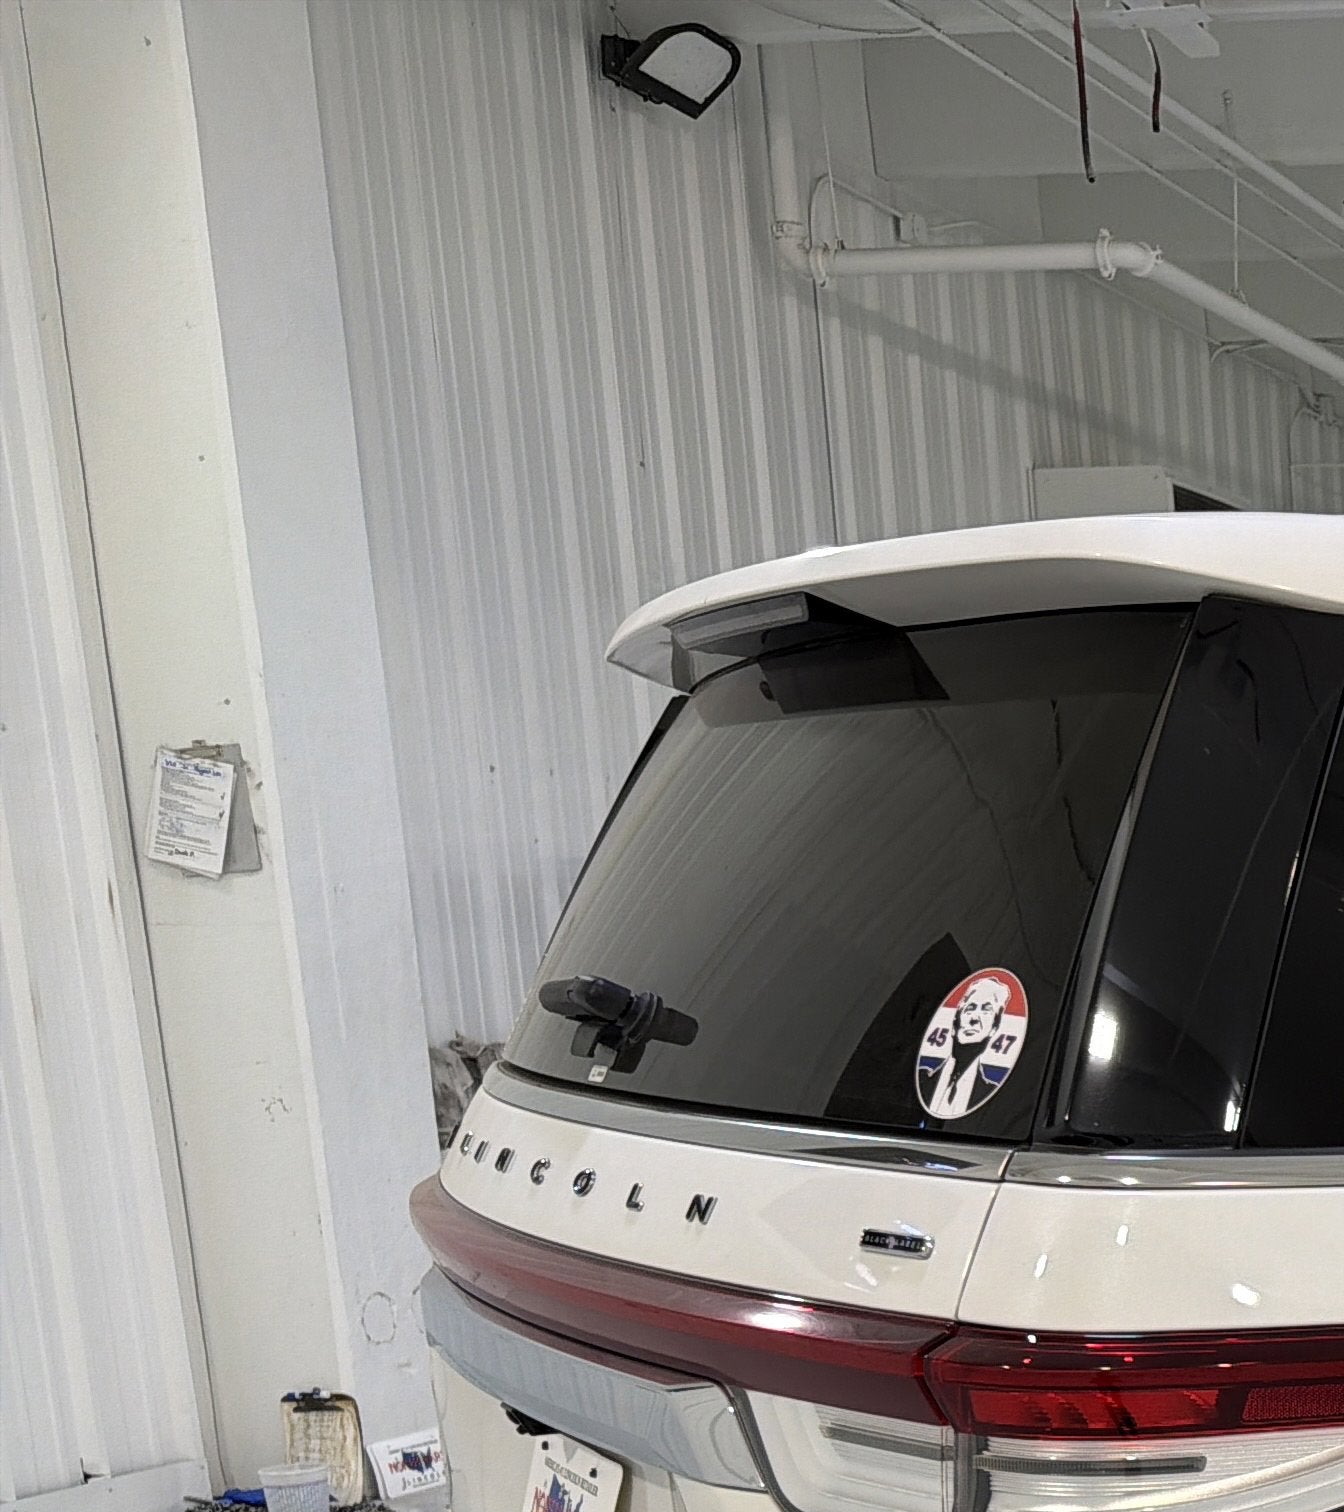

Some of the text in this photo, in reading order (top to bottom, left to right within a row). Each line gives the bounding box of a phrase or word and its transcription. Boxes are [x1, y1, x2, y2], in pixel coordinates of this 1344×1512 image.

[926, 1027, 1018, 1055] 45 47
[460, 1130, 719, 1225] LINCOLN
